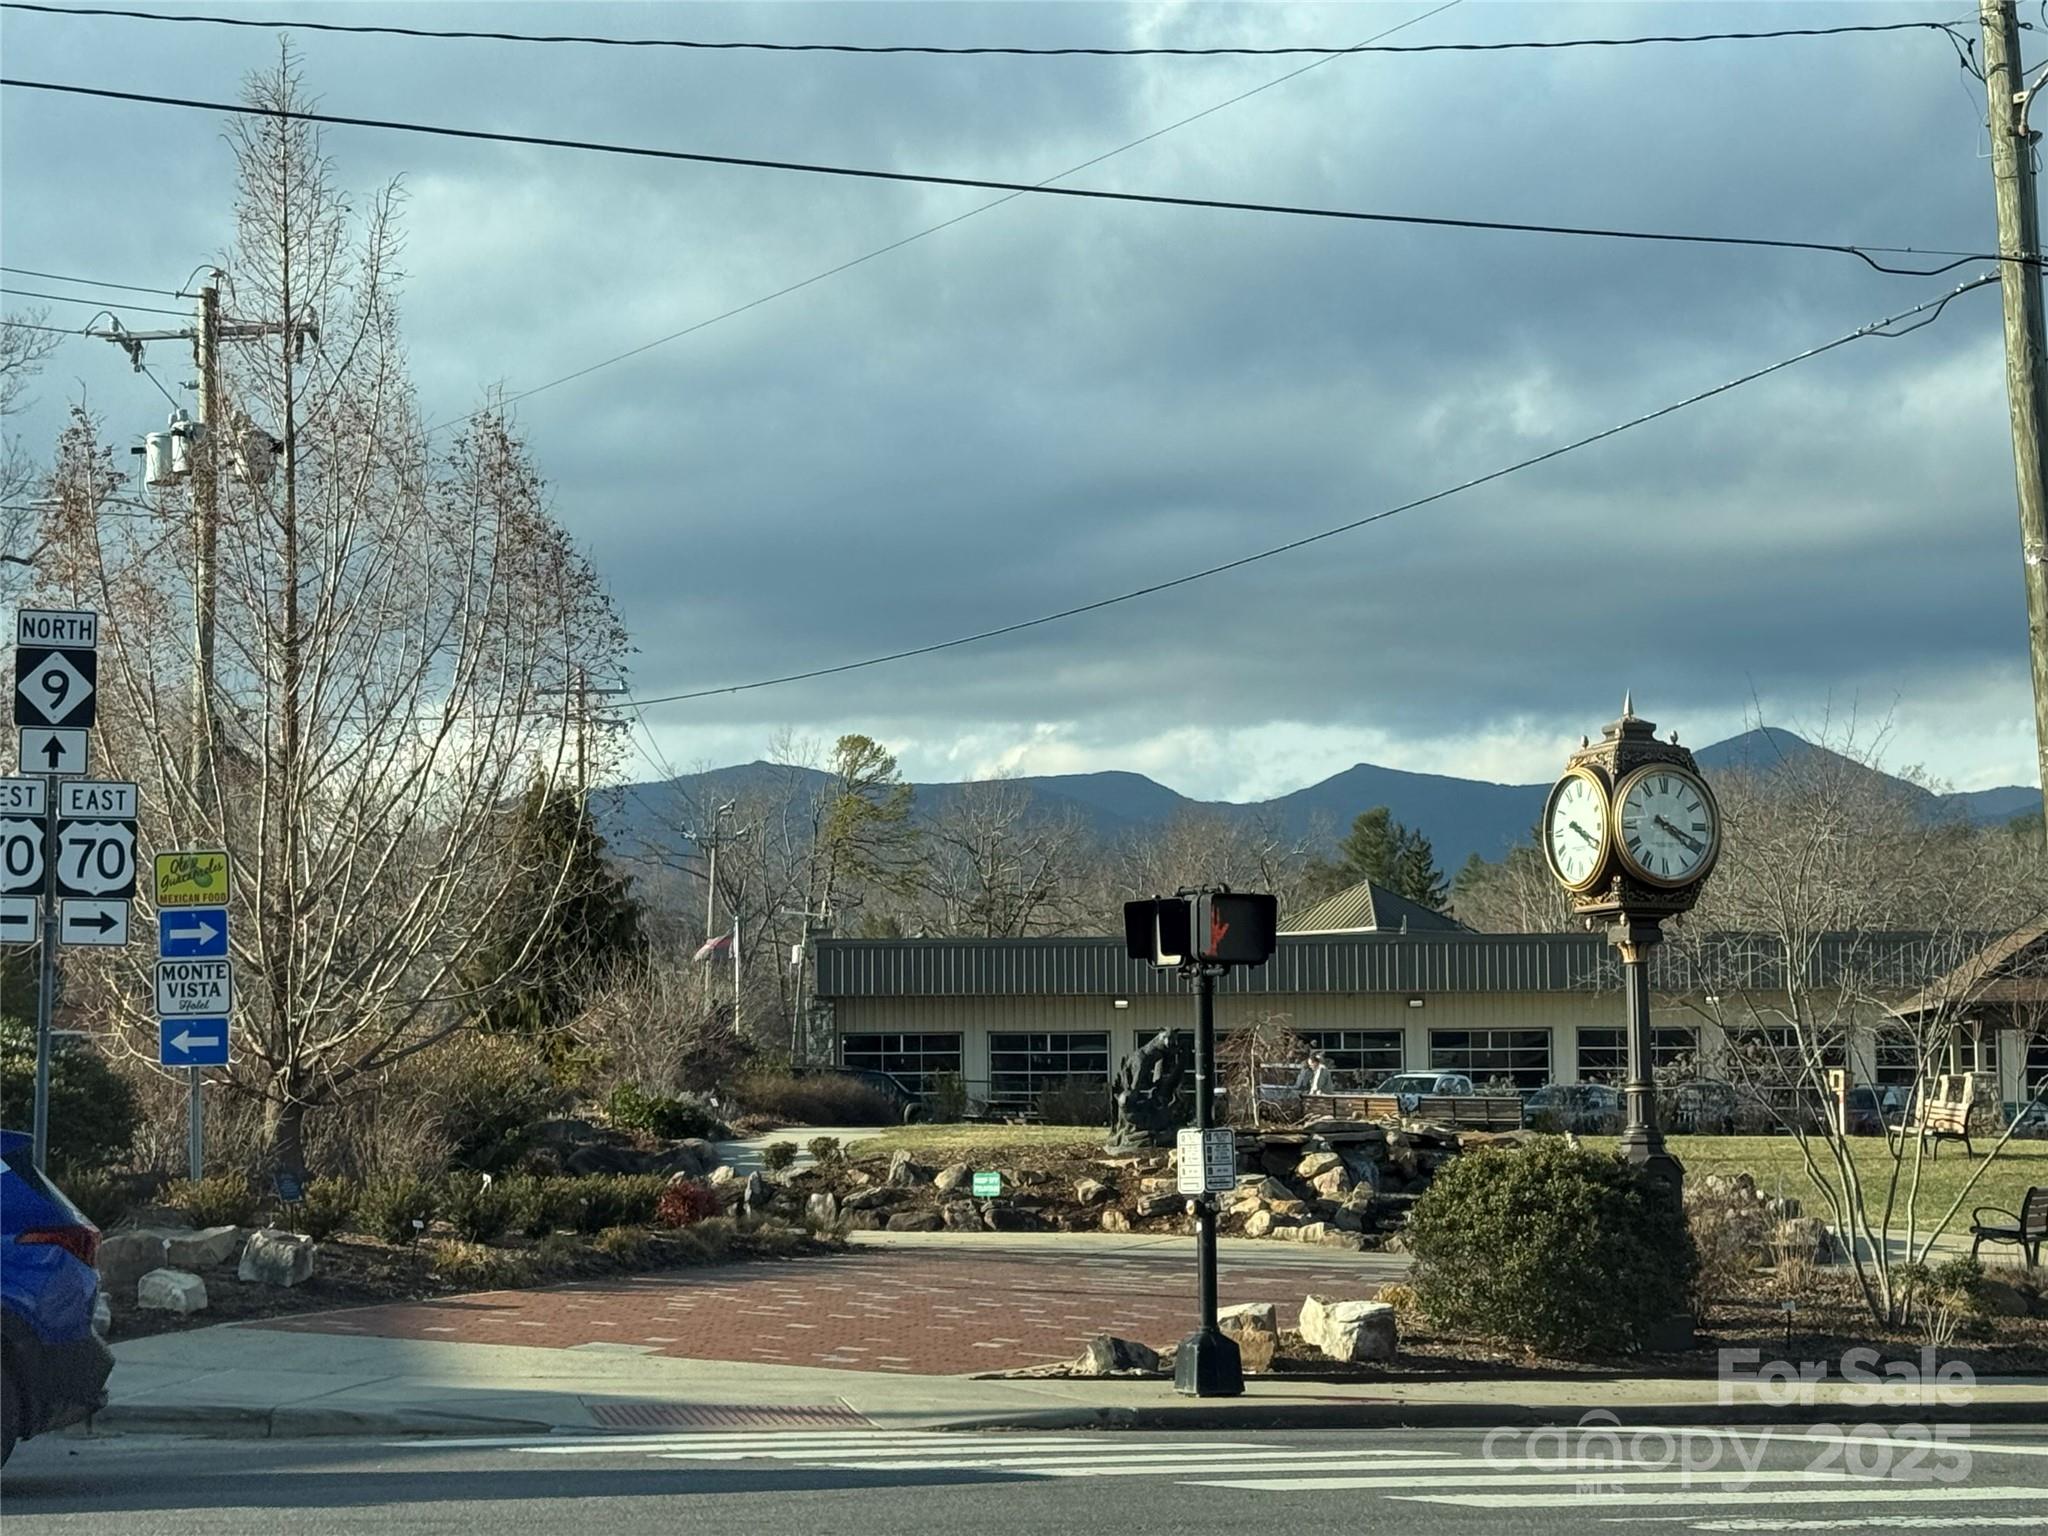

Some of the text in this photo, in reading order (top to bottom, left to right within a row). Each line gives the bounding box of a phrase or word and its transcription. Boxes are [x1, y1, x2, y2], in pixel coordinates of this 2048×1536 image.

[23, 617, 91, 640] NORTH
[42, 669, 69, 710] 9
[72, 789, 127, 811] EAST
[0, 835, 34, 877] 0
[69, 838, 125, 880] 70
[160, 892, 227, 904] MEXICAN FOOD
[162, 964, 227, 981] MONTE
[167, 982, 221, 998] VISTA
[179, 999, 210, 1012] Hotel
